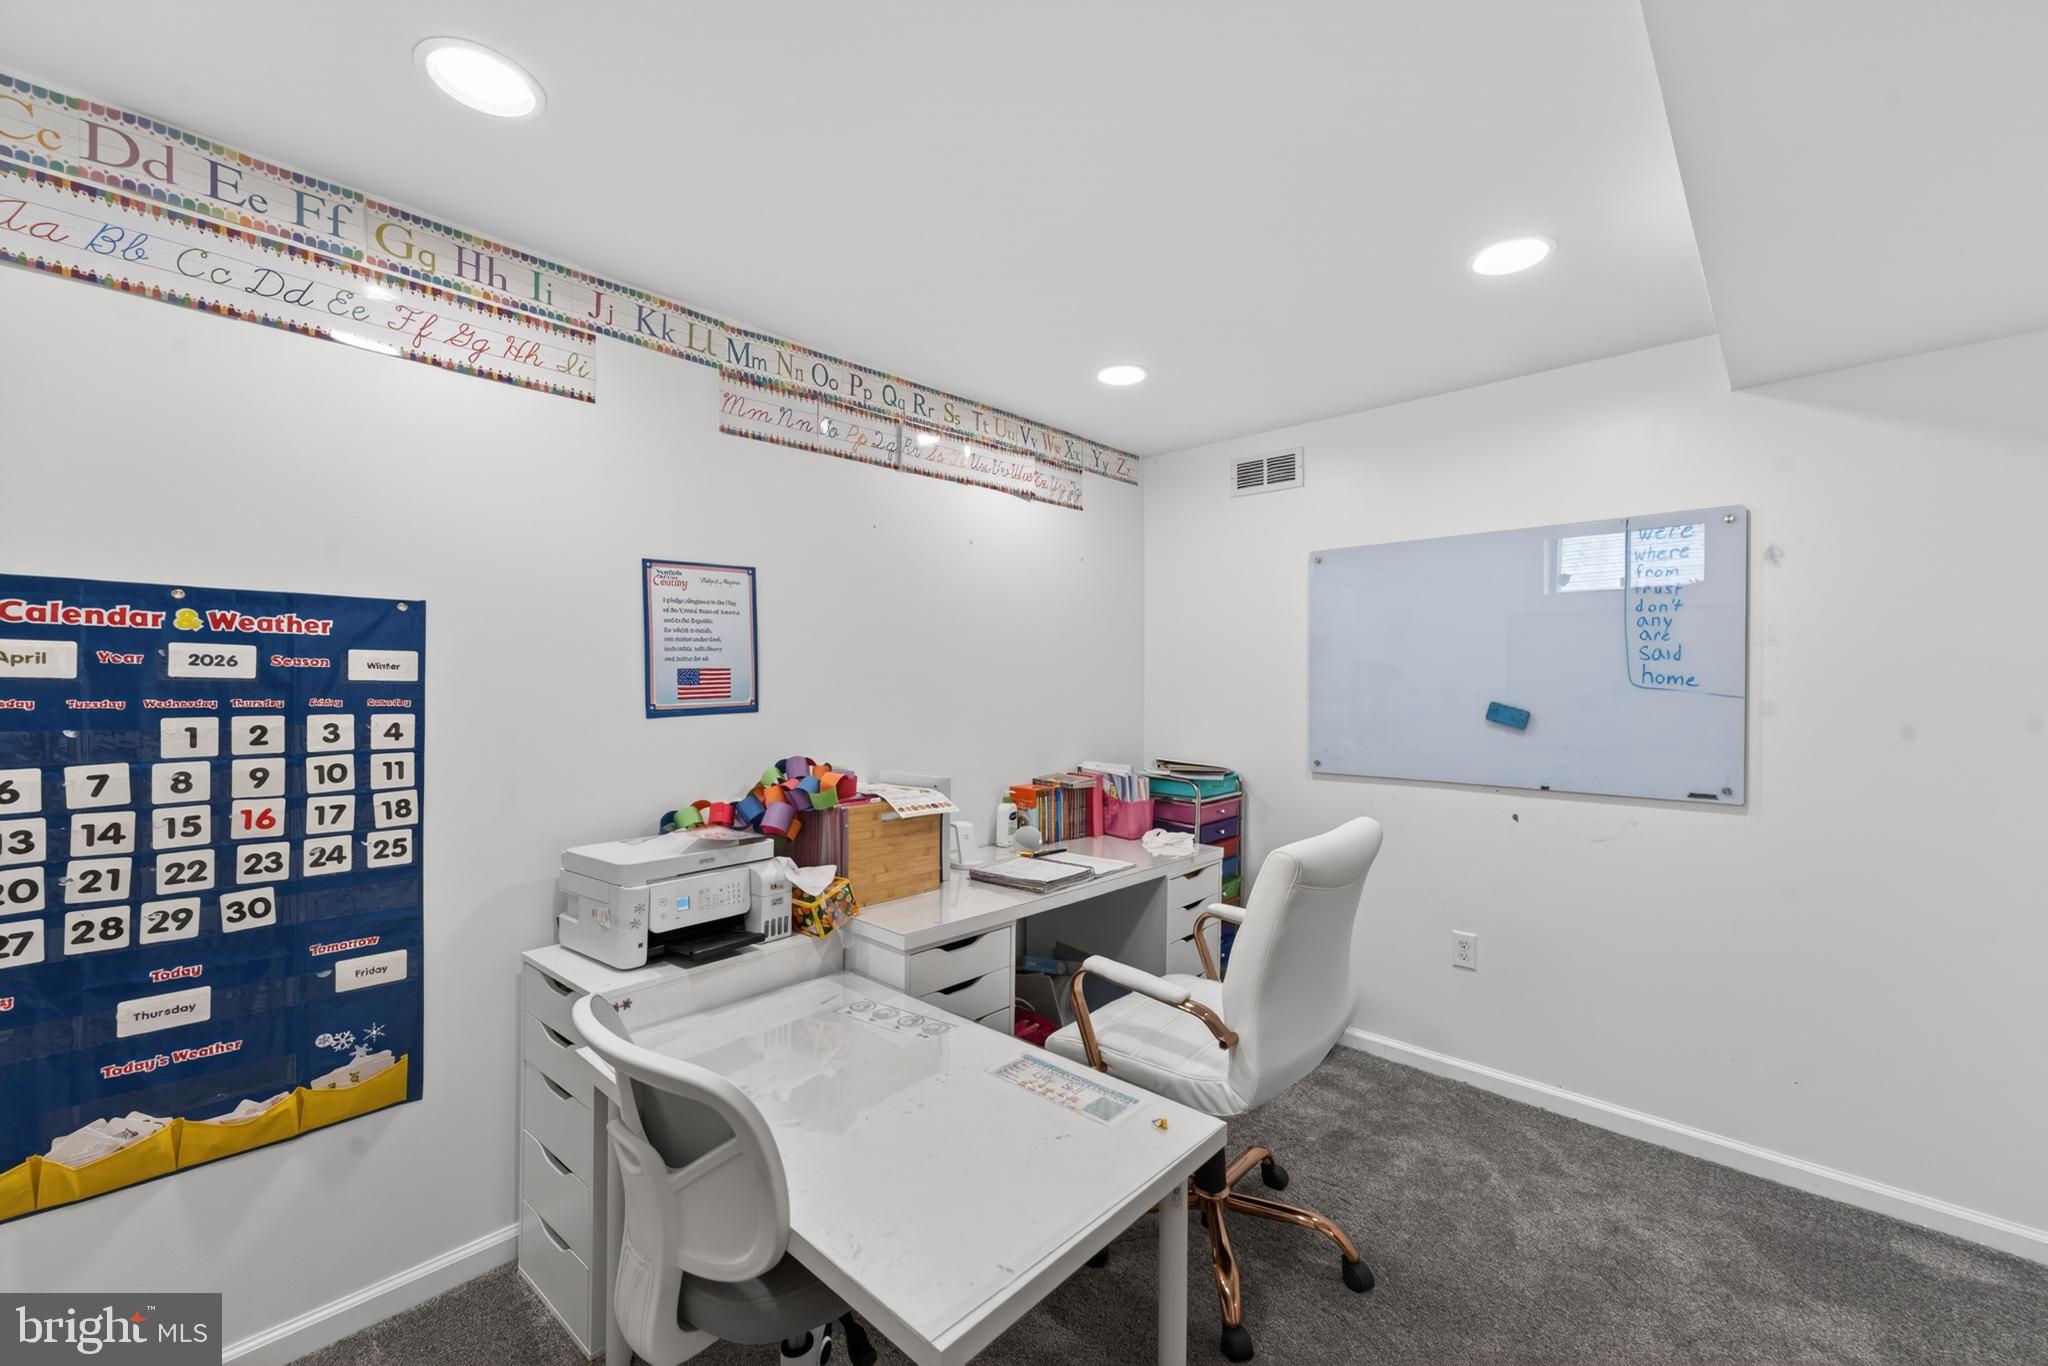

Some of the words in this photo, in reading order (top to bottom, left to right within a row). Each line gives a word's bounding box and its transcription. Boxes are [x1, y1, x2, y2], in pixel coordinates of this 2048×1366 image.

[0, 95, 62, 151] Cc
[80, 118, 179, 185] Dd
[204, 157, 269, 214] Ee
[290, 187, 353, 239] Ff
[375, 222, 437, 275] Gg
[455, 244, 512, 292] Hh
[529, 269, 553, 306] Ii
[587, 290, 614, 326] Jj
[636, 302, 676, 344] Kk
[687, 321, 717, 357] Ll
[725, 337, 767, 372] Mm
[776, 350, 804, 383] Nn
[811, 362, 839, 391] Oo
[850, 373, 873, 401] Pp
[882, 384, 906, 413] Qq
[913, 392, 935, 418] Rr
[943, 401, 960, 426] Ss
[972, 410, 989, 434] Tt
[1020, 425, 1037, 448] Vv
[85, 222, 149, 262] Bb
[176, 247, 233, 285] Cc
[244, 268, 314, 307] Dd
[327, 289, 370, 322] Ee
[387, 304, 439, 349] Ff
[443, 322, 491, 364] Gg
[502, 335, 544, 367] Hh
[556, 352, 590, 379] Ii
[723, 391, 773, 424] Mm
[778, 406, 814, 433] Nn
[1639, 524, 1695, 541] were
[1634, 545, 1690, 562] where
[1636, 563, 1680, 578] from
[1635, 599, 1683, 613] don't
[0, 599, 166, 628] Calendar
[173, 608, 204, 631] &
[206, 609, 333, 635] Weather
[1636, 615, 1673, 632] any
[1639, 630, 1670, 641] are
[0, 650, 47, 667] April
[97, 650, 144, 664] Year
[188, 653, 239, 668] 2026
[271, 655, 330, 668] Season
[1639, 644, 1682, 661] said
[366, 661, 401, 671] Winter
[1641, 664, 1700, 687] home
[66, 699, 126, 711] Tuesday
[184, 727, 198, 749] 1
[248, 724, 269, 747] 2
[323, 722, 341, 744] 3
[384, 722, 403, 741] 4
[0, 780, 20, 804] 6
[86, 774, 110, 798] 7
[170, 772, 193, 795] 8
[249, 767, 270, 789] 9
[313, 763, 348, 785] 10
[382, 760, 404, 780] 11
[0, 829, 35, 855] 3
[80, 822, 127, 847] 14
[163, 815, 202, 839] 15
[240, 808, 276, 831] 16
[314, 804, 347, 825] 17
[381, 799, 412, 820] 18
[77, 868, 121, 894] 21
[164, 859, 208, 885] 22
[243, 851, 284, 875] 23
[308, 844, 347, 868] 24
[373, 837, 408, 859] 25
[70, 916, 124, 945] 28
[146, 907, 194, 934] 29
[225, 897, 272, 923] 30
[310, 936, 379, 956] Tomorrow
[150, 964, 202, 983] Today
[354, 964, 388, 979] Friday
[133, 1002, 196, 1022] Thursday
[101, 1050, 169, 1079] Today's
[173, 1039, 243, 1064] Weather
